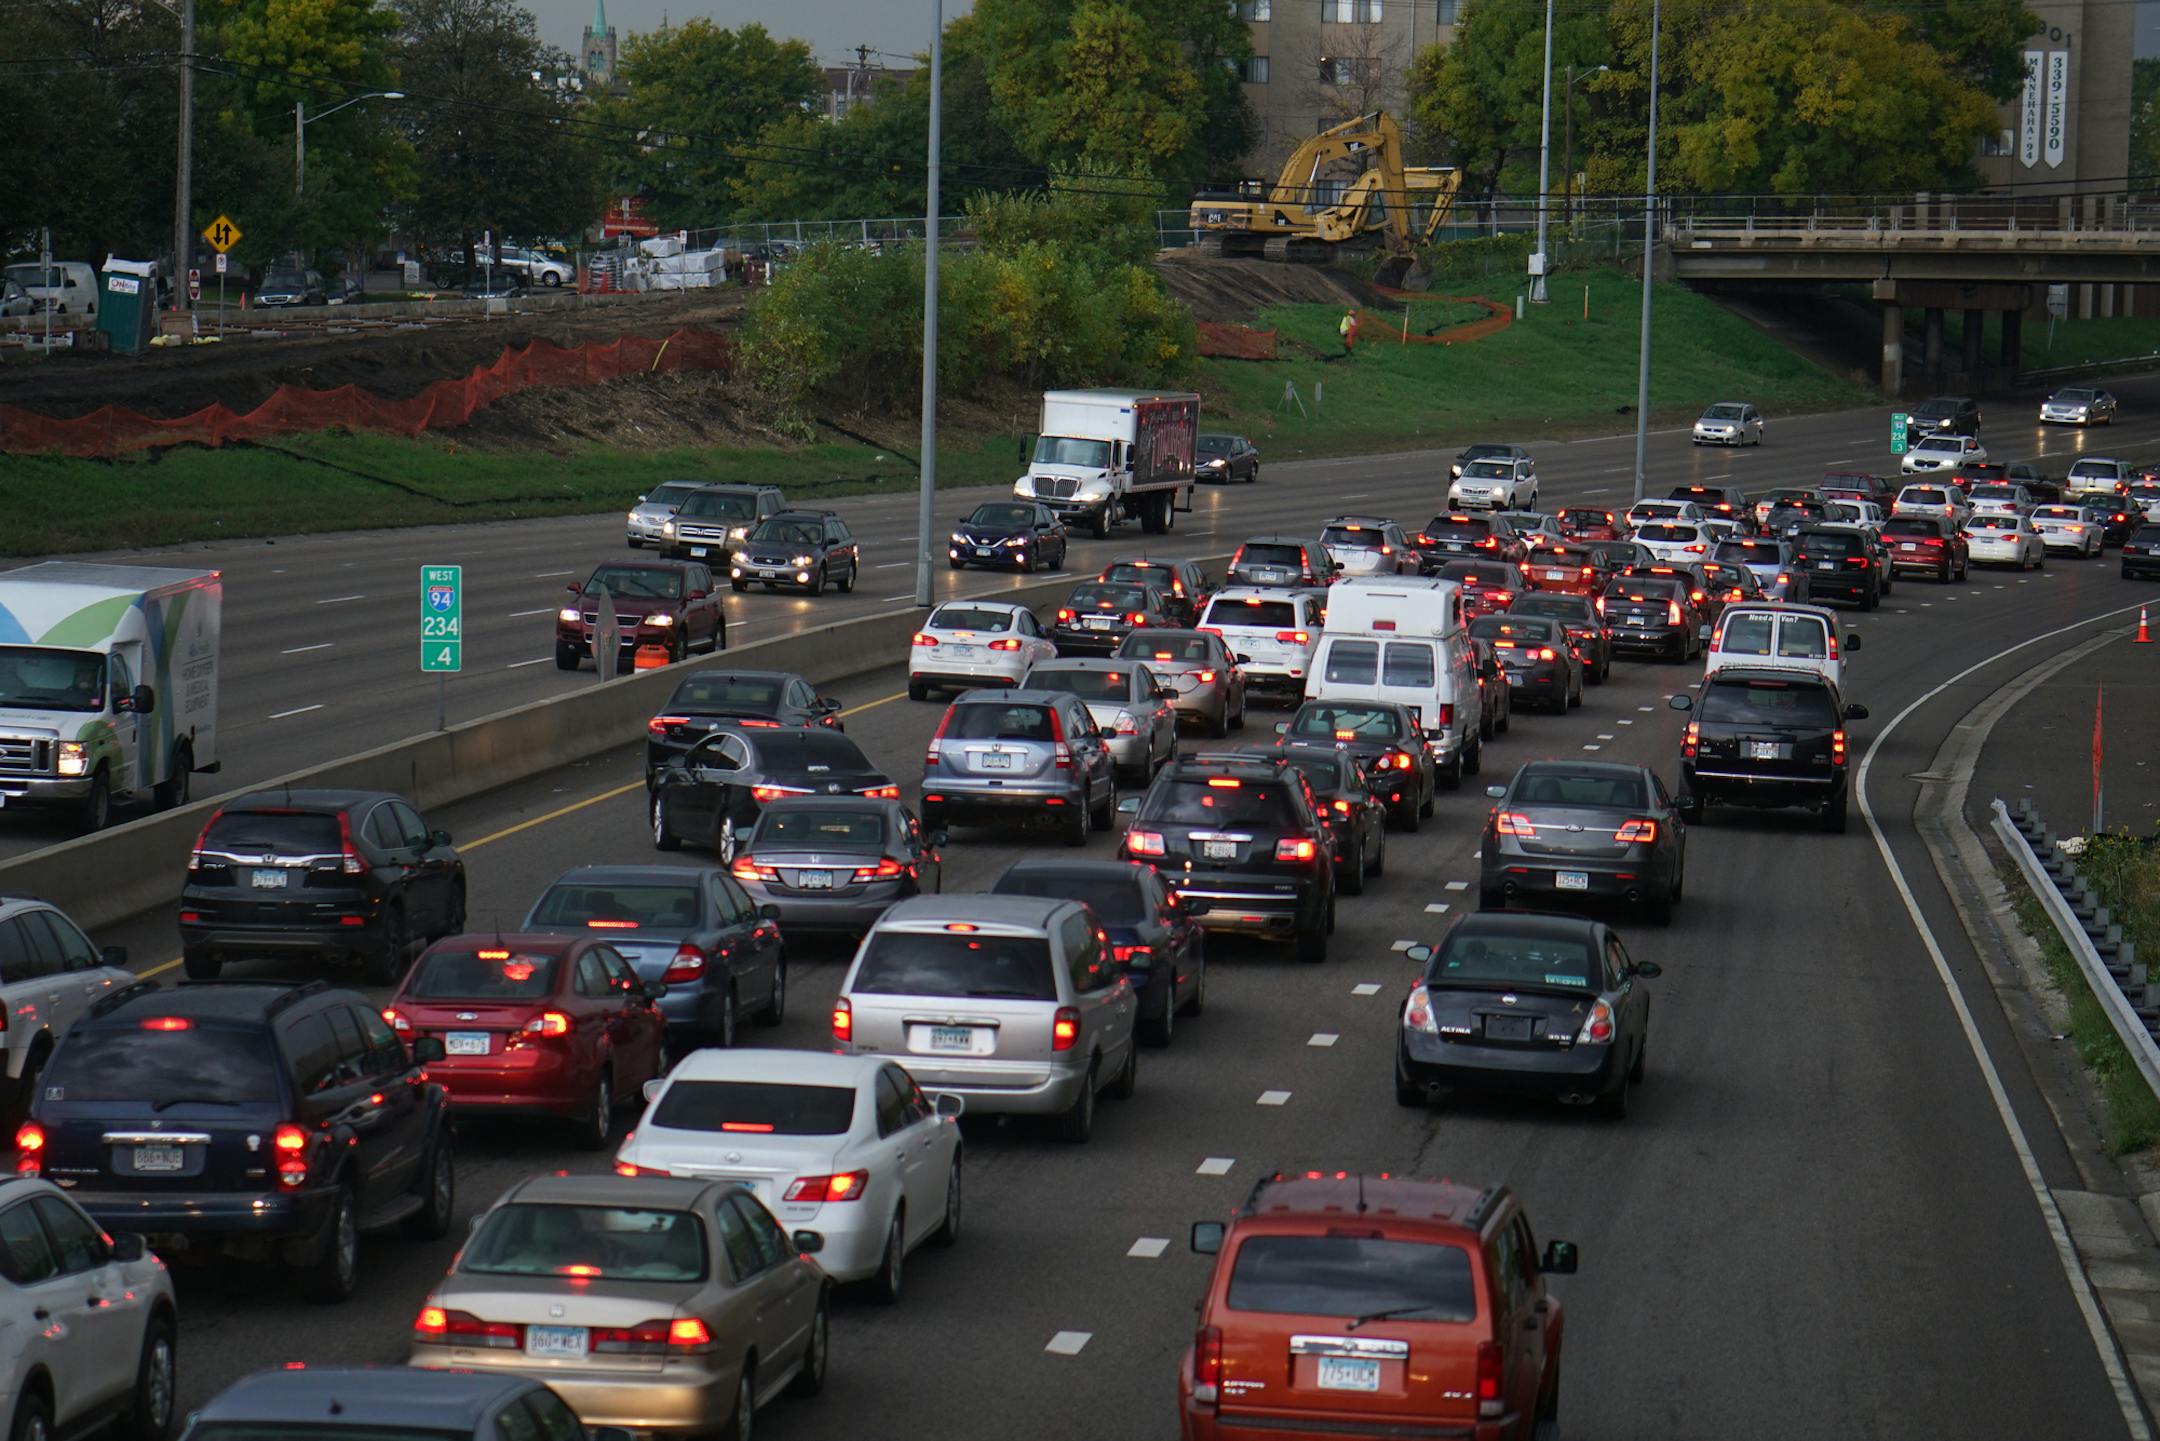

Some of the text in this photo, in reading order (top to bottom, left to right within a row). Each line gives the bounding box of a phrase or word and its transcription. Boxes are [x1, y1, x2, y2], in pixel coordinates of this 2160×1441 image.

[429, 571, 454, 581] WEST
[431, 591, 451, 607] 94
[1748, 614, 1767, 622] Need
[1781, 615, 1799, 623] Van?
[424, 616, 458, 636] 234
[430, 646, 452, 666] .4
[1440, 1026, 1472, 1034] ALTIMA
